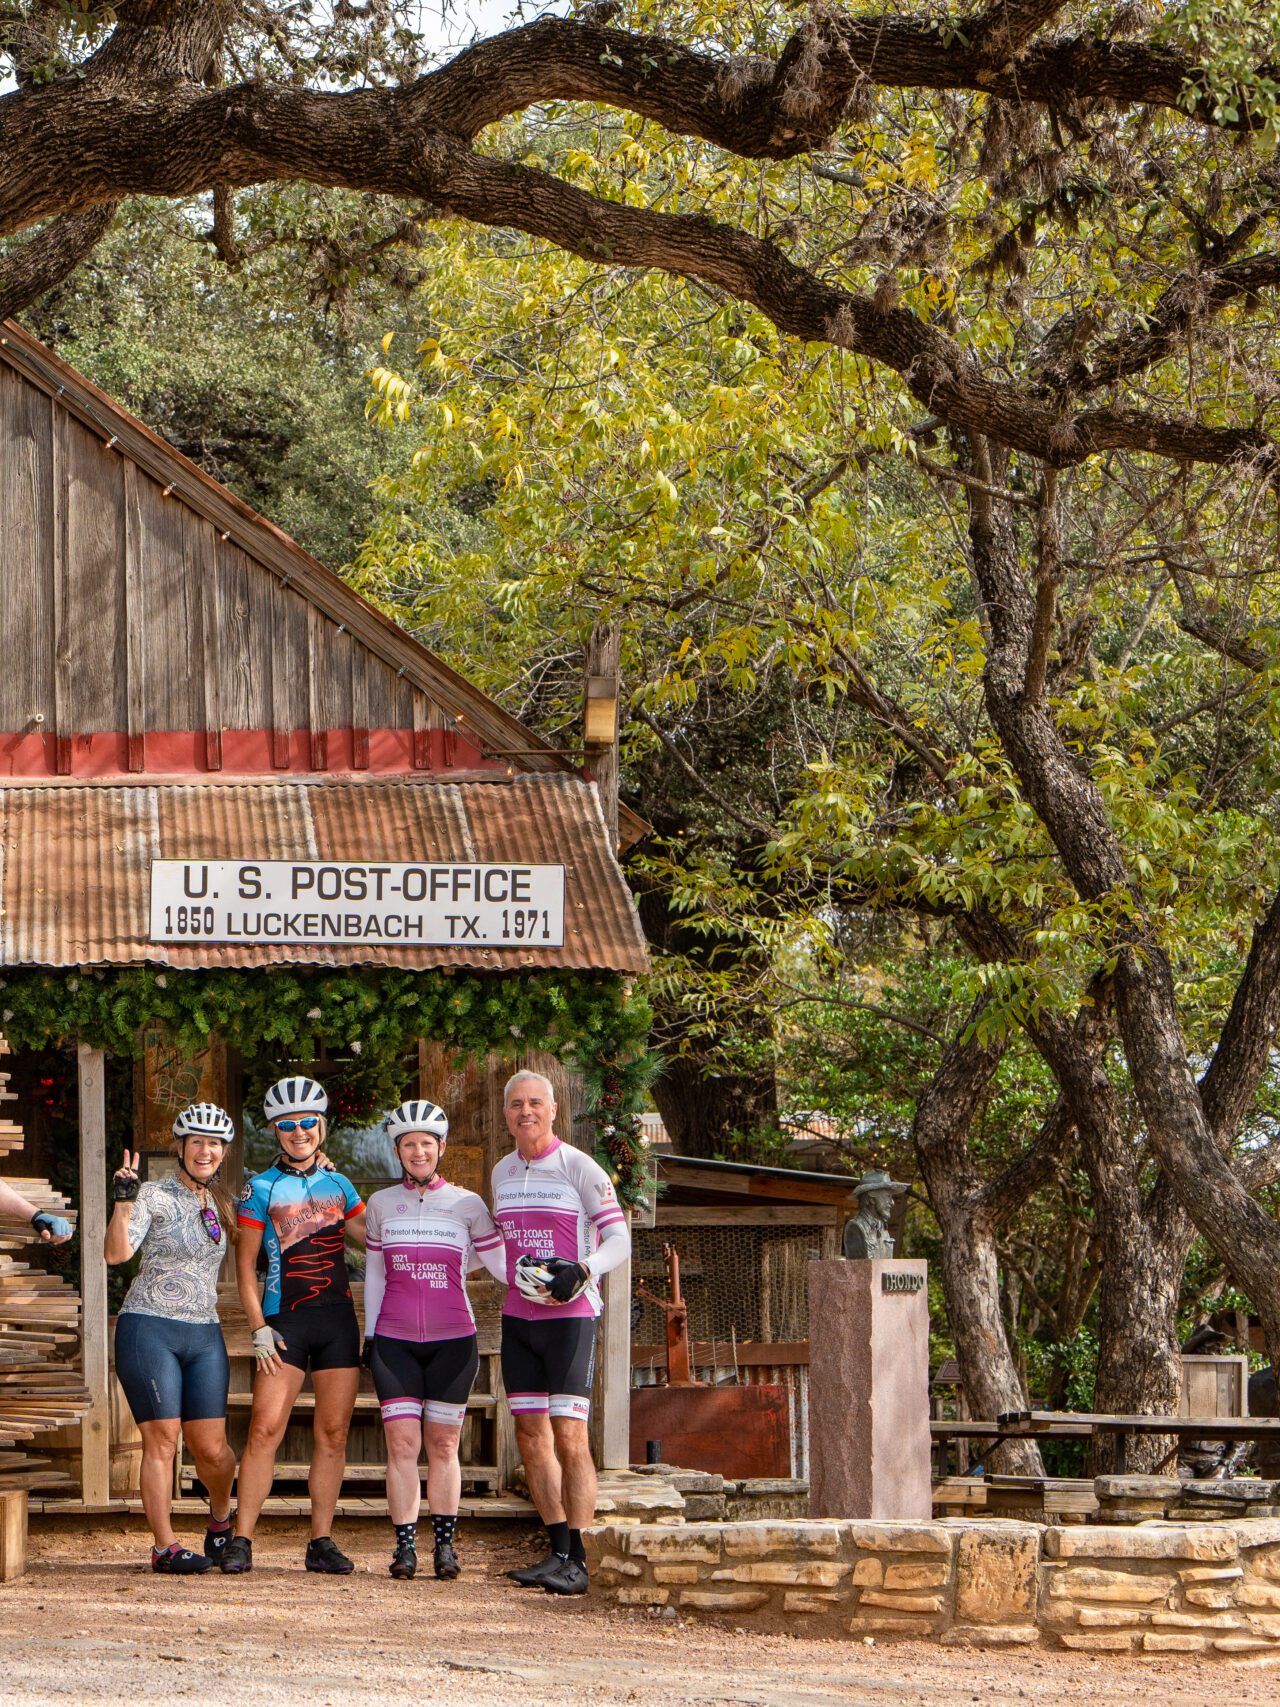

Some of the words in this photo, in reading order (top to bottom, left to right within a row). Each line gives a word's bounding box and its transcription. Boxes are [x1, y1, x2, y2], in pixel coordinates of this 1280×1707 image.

[183, 865, 219, 899] U.
[238, 866, 271, 900] S.
[291, 867, 532, 902] POST-OFFICE
[164, 905, 215, 935] 1850
[227, 912, 422, 938] LUCKENBACH
[445, 915, 487, 939] TX.
[501, 910, 551, 939] 1971
[500, 1192, 517, 1201] Bristol
[518, 1192, 536, 1200] Myers
[537, 1191, 561, 1200] Squibb
[278, 1194, 343, 1235] Haleakala
[411, 1229, 433, 1238] Myers
[434, 1229, 457, 1238] Squibb
[583, 1221, 592, 1244] Bristol
[535, 1249, 555, 1258] RIDE
[584, 1246, 592, 1256] My
[391, 1255, 408, 1263] 2021
[393, 1263, 415, 1271] COAST
[430, 1280, 449, 1289] RIDE
